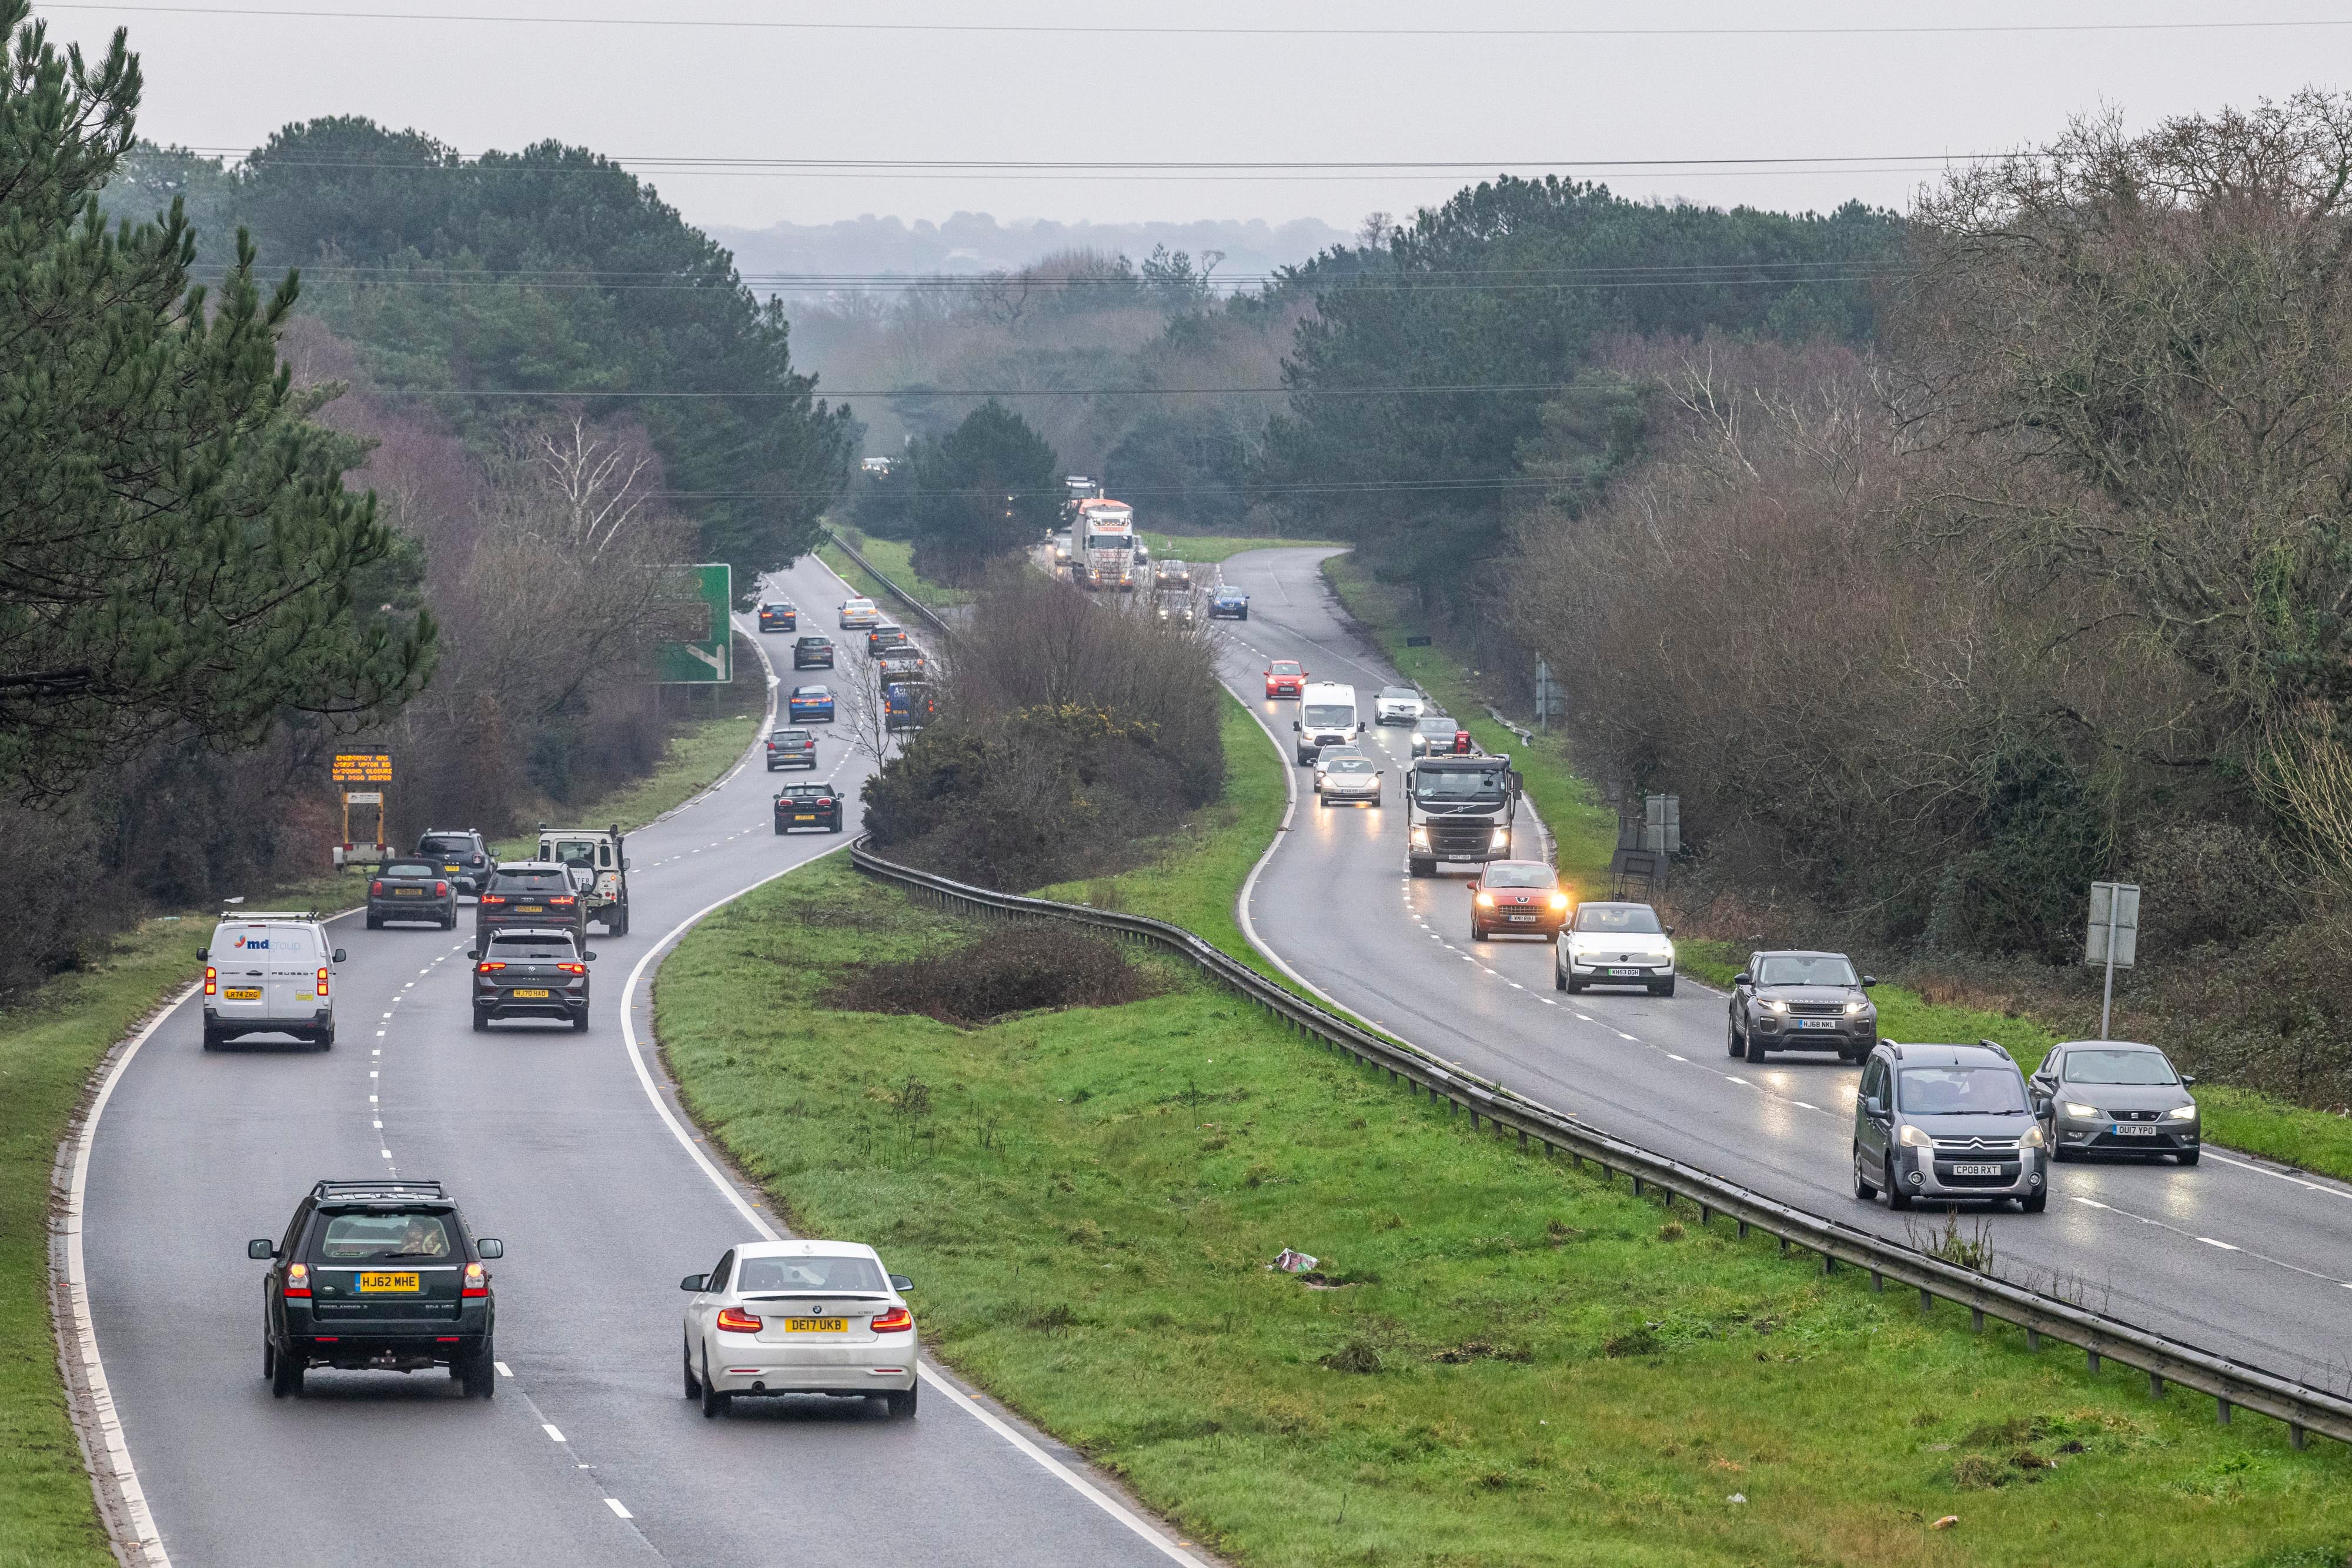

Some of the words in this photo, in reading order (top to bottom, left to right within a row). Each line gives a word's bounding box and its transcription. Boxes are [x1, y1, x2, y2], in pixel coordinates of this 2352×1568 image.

[1956, 1166, 1979, 1174] CP08
[1981, 1166, 1997, 1174] RXT
[363, 1276, 391, 1287] HJ62
[394, 1276, 416, 1287] MHE
[792, 1319, 816, 1330] DE17
[820, 1319, 841, 1330] UKB
